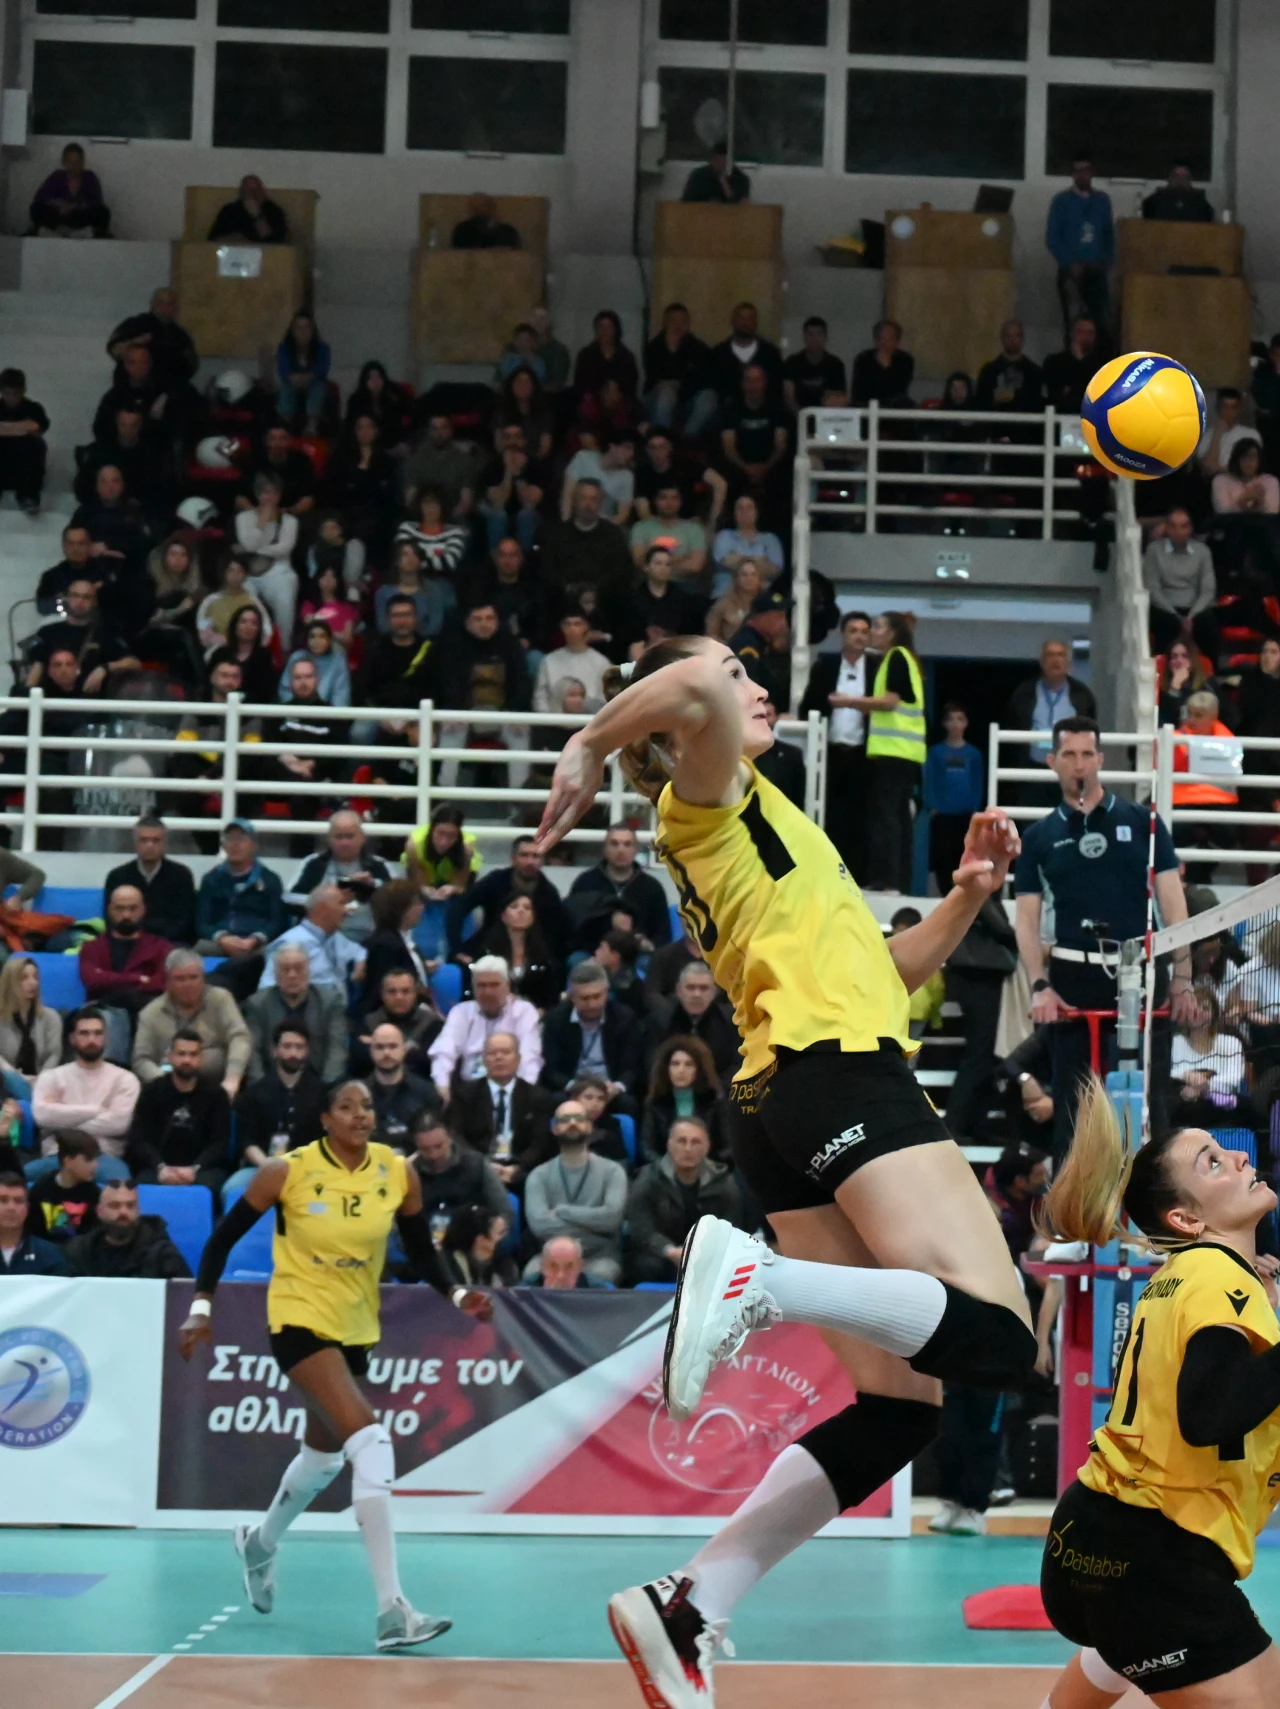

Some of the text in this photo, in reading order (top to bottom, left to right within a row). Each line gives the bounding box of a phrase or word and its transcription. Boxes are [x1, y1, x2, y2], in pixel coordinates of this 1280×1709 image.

[810, 1123, 865, 1170] PLANET
[341, 1195, 362, 1218] 12
[457, 1358, 524, 1386] τον
[1105, 1317, 1145, 1427] 11
[1061, 1548, 1131, 1578] pastabar
[1122, 1648, 1188, 1677] PLANET
